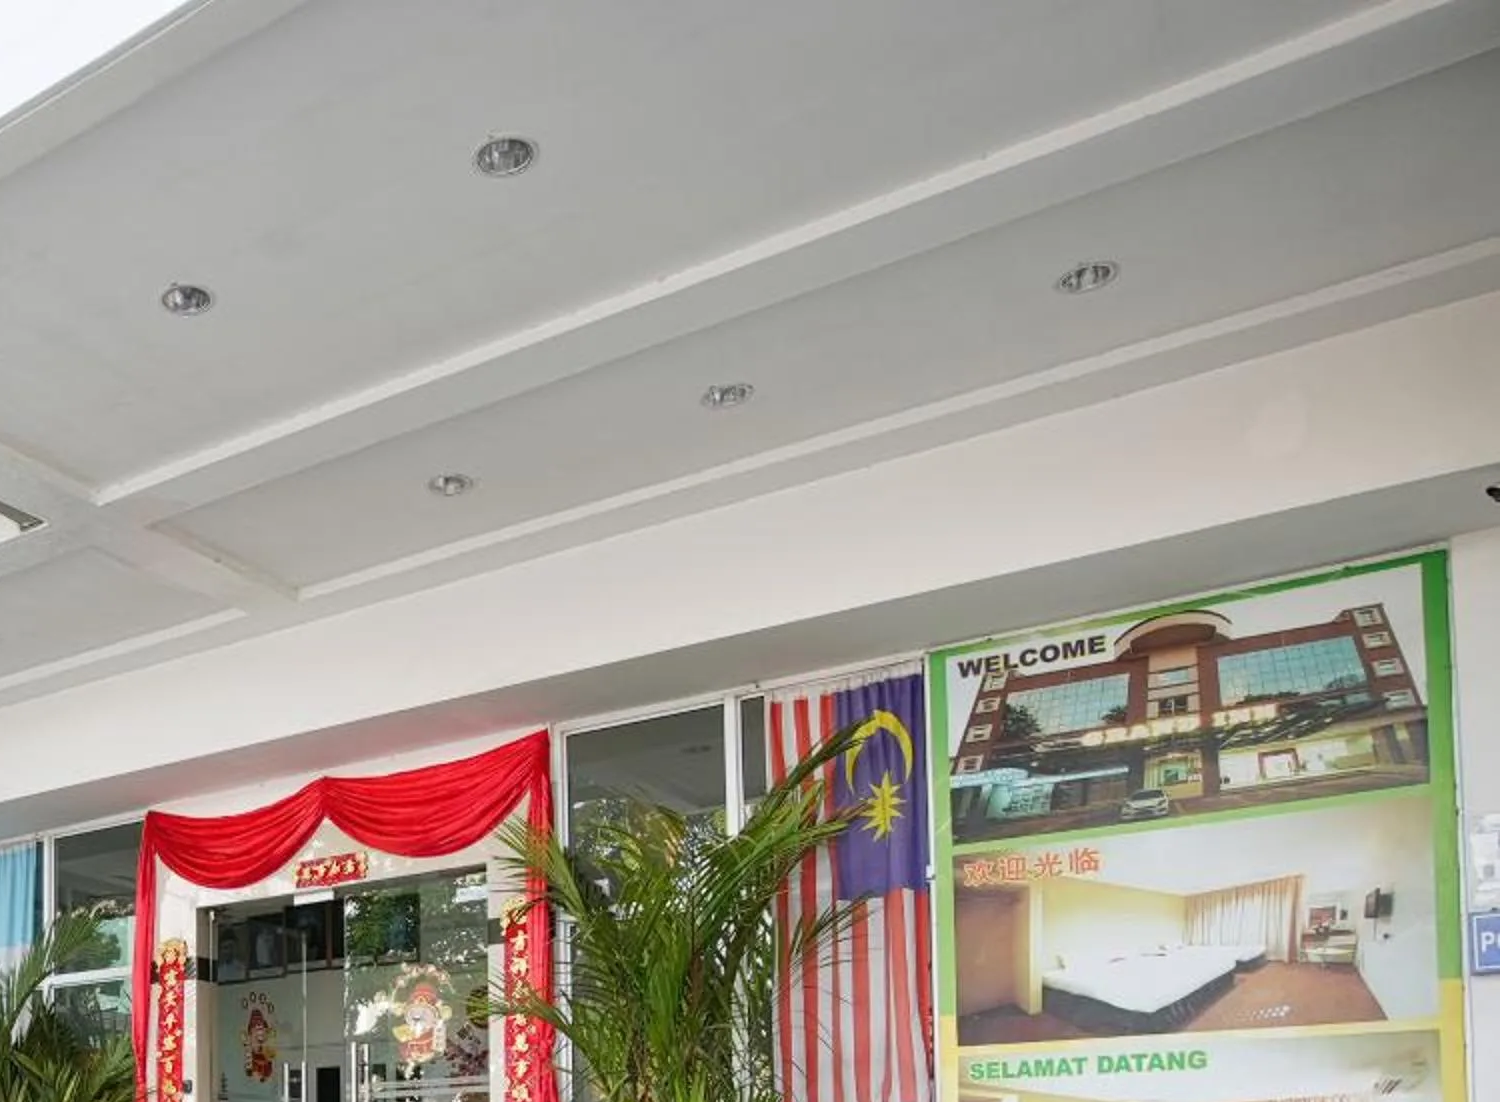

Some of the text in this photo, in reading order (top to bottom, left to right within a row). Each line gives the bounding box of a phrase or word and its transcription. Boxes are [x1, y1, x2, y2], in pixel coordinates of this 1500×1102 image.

[957, 635, 1106, 679] WELCOME
[963, 847, 1100, 887] 欢迎光临
[970, 1050, 1208, 1080] SELAMAT DATANG
